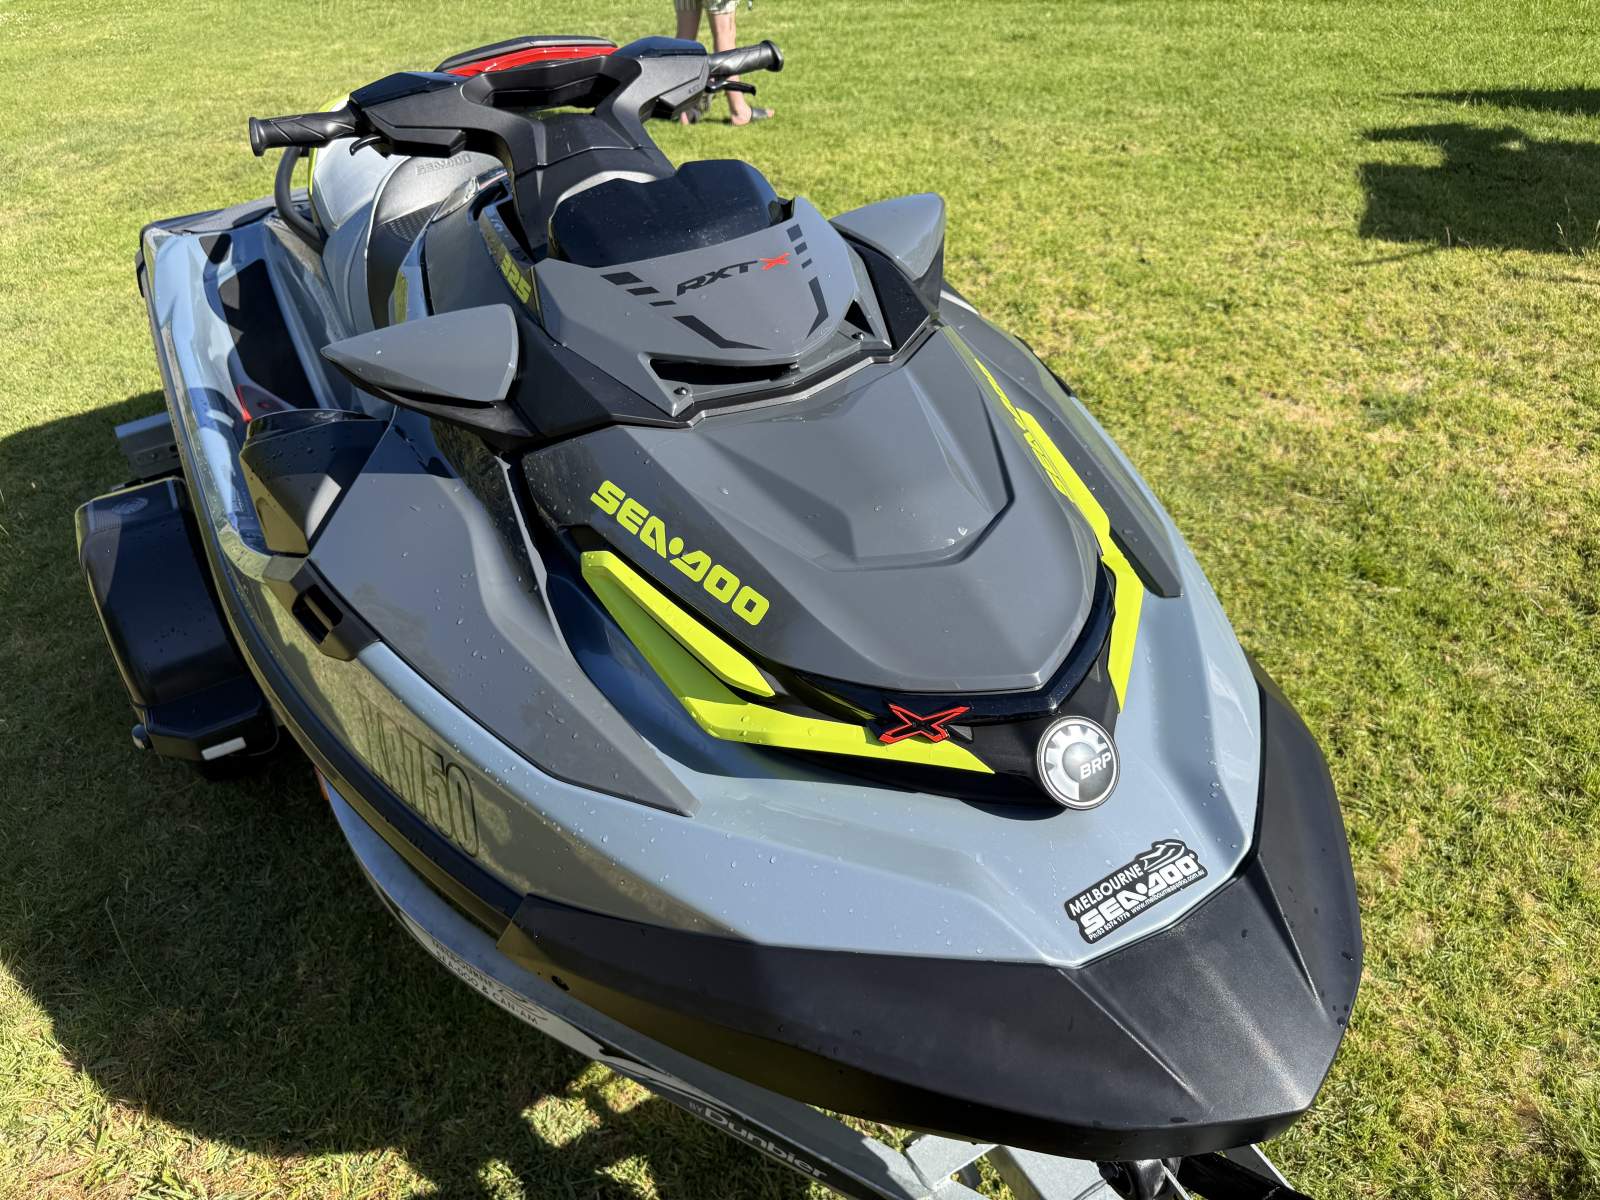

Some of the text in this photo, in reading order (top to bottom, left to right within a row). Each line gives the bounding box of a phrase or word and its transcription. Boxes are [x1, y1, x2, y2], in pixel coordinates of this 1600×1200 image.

[500, 253, 532, 304] 325
[676, 259, 758, 297] RXT
[1078, 752, 1113, 780] BRP
[1068, 863, 1145, 917] MELBOURNE
[704, 1106, 828, 1178] Dunbier
